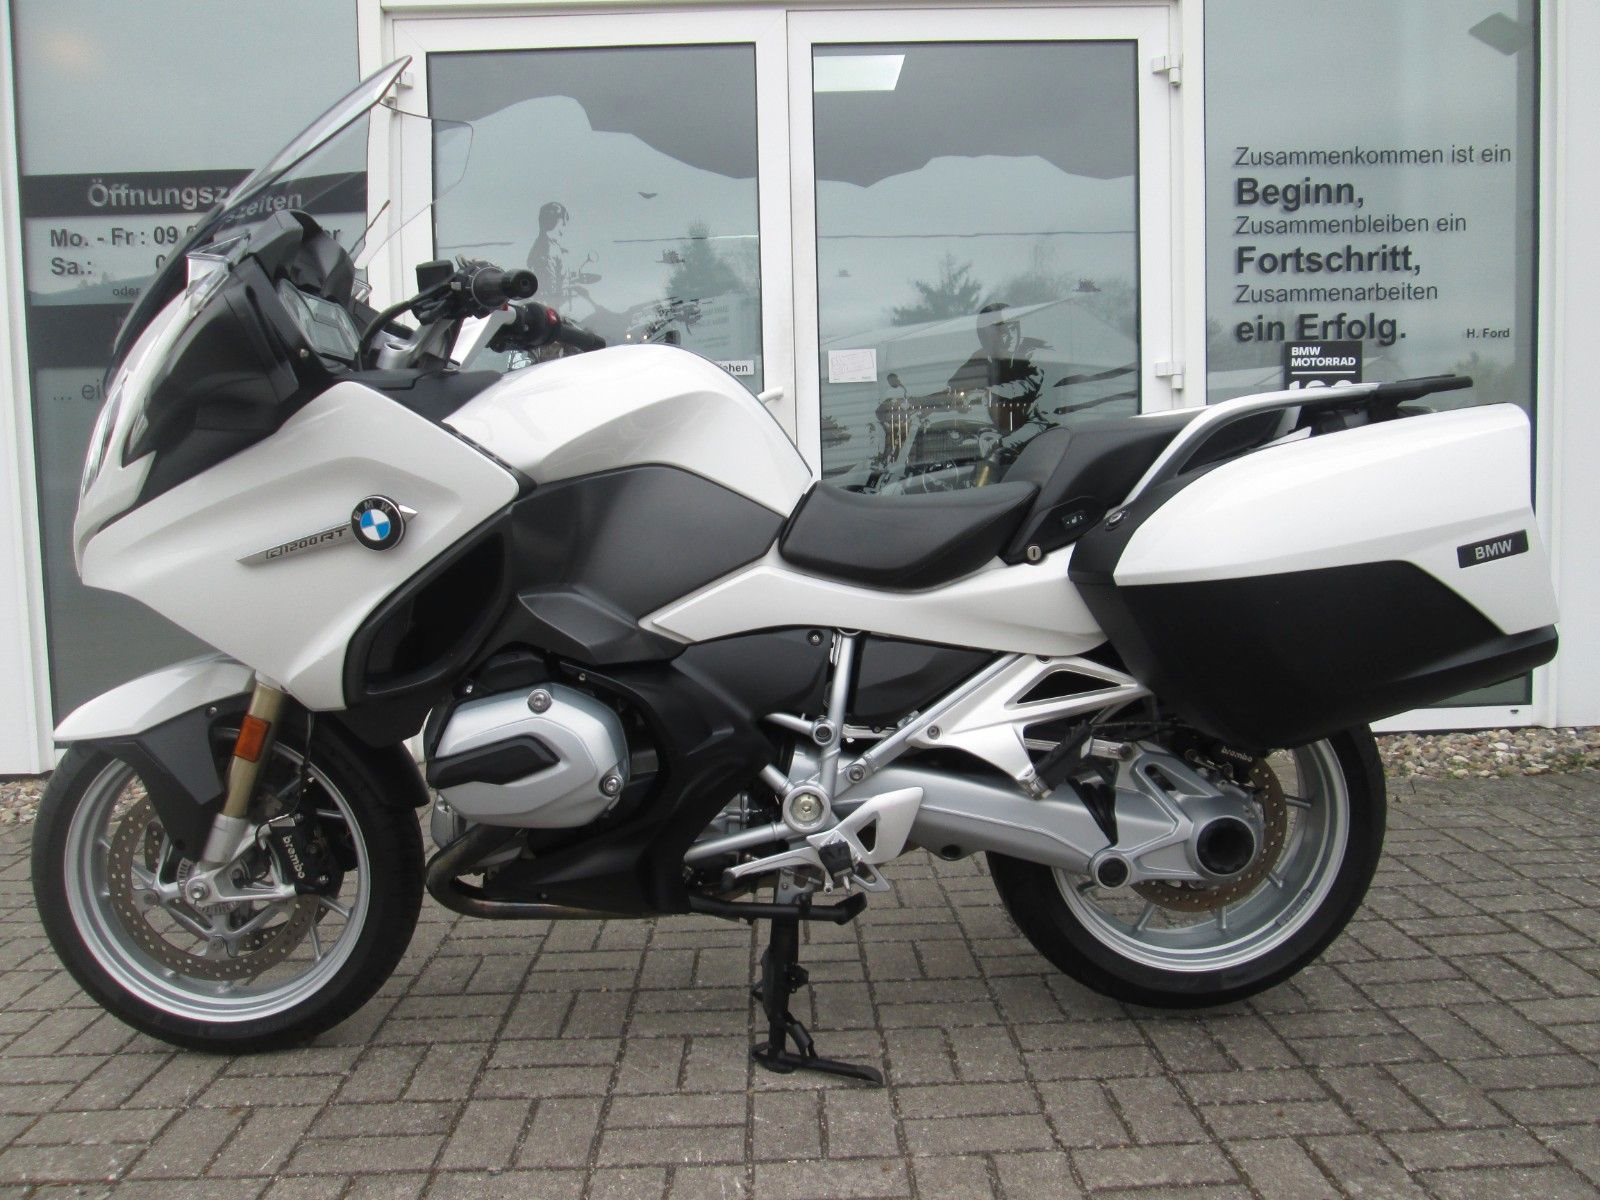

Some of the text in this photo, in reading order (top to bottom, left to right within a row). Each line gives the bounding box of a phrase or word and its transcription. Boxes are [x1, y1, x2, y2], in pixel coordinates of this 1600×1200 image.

[1236, 144, 1512, 166] Zusammenkommen ist ein
[1237, 176, 1364, 212] Beginn,
[1236, 213, 1467, 235] Zusammenbleiben ein
[50, 228, 89, 247] Mo.
[51, 256, 93, 276] Sa.:
[1236, 244, 1421, 276] Fortschritt,
[1236, 282, 1439, 304] Zusammenarbeiten
[1236, 312, 1407, 347] ein Erfolg.
[1466, 327, 1511, 339] H. Ford
[1291, 346, 1321, 356] BMW
[1291, 356, 1357, 367] MOTORRAD
[353, 500, 392, 521] BMW
[1475, 539, 1512, 560] BMW
[1221, 746, 1253, 762] brembo
[282, 834, 305, 879] brembo
